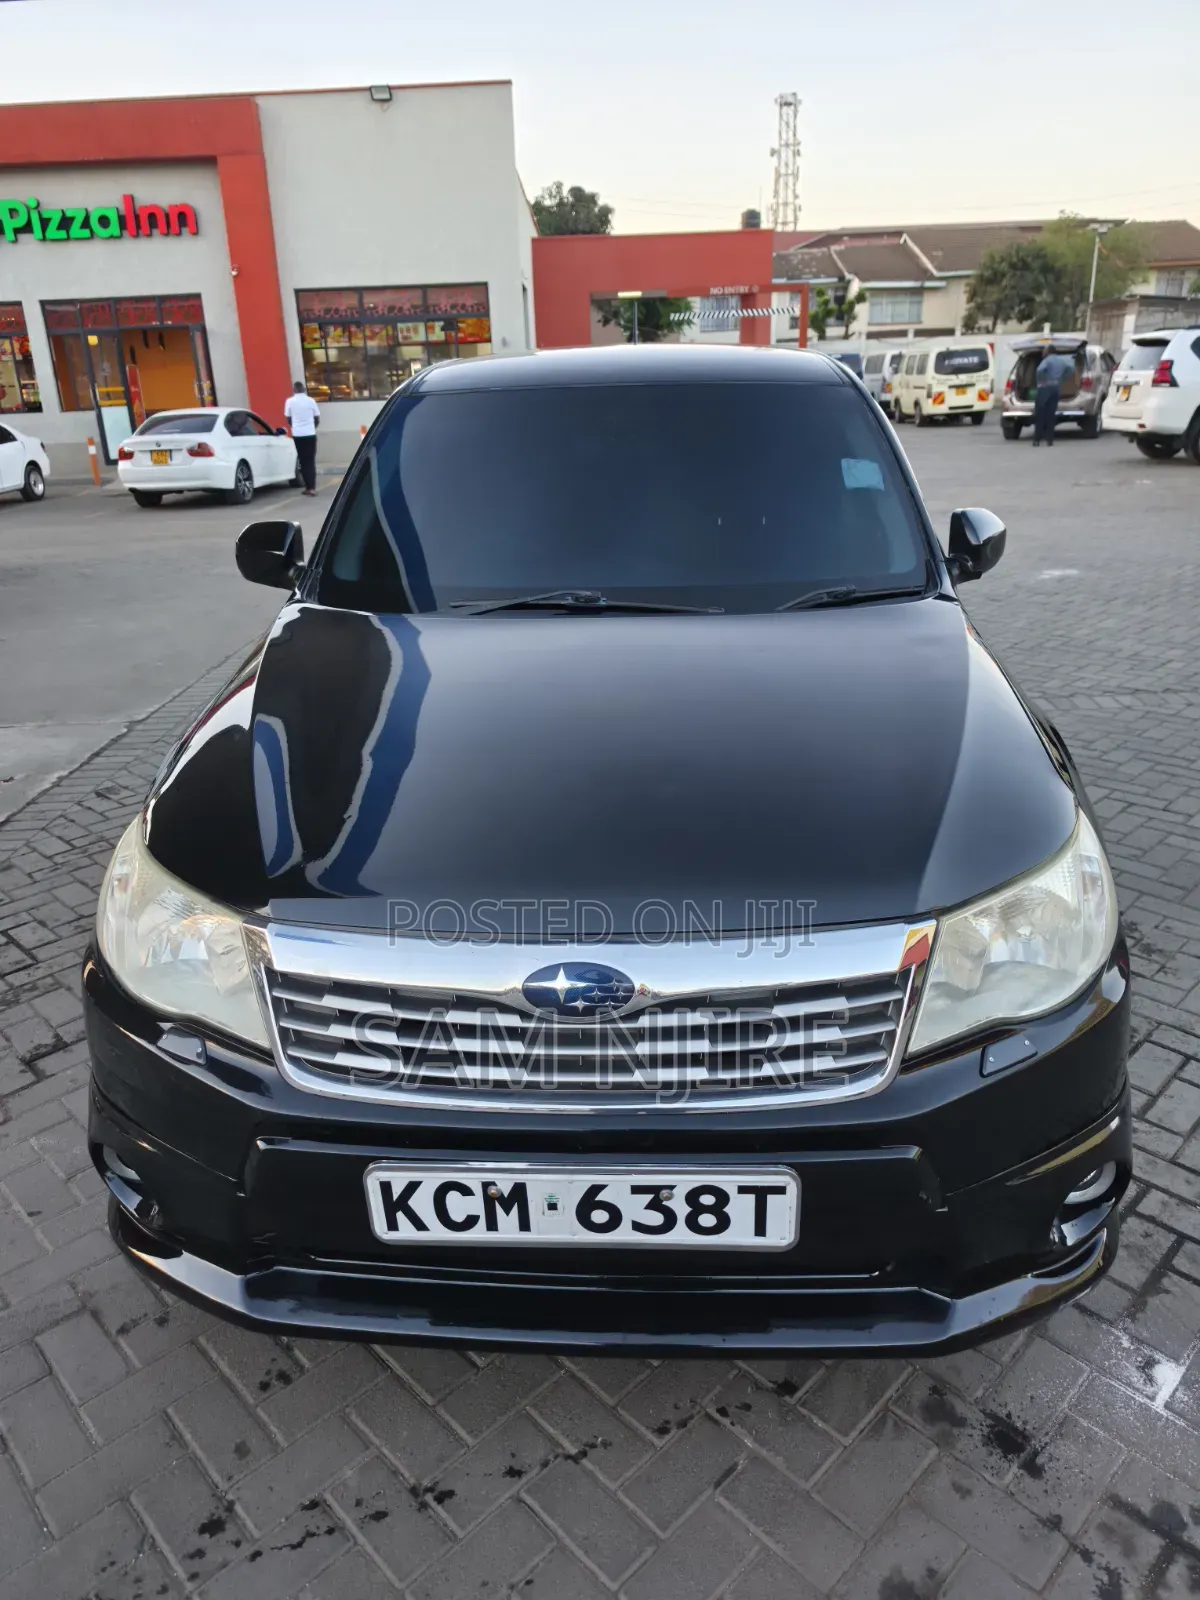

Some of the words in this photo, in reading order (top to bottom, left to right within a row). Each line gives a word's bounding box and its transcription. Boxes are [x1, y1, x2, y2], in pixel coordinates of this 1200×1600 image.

[709, 286, 723, 295] NO
[723, 284, 750, 294] ENTRY
[378, 1180, 532, 1233] KCM
[575, 1183, 788, 1238] 638T
